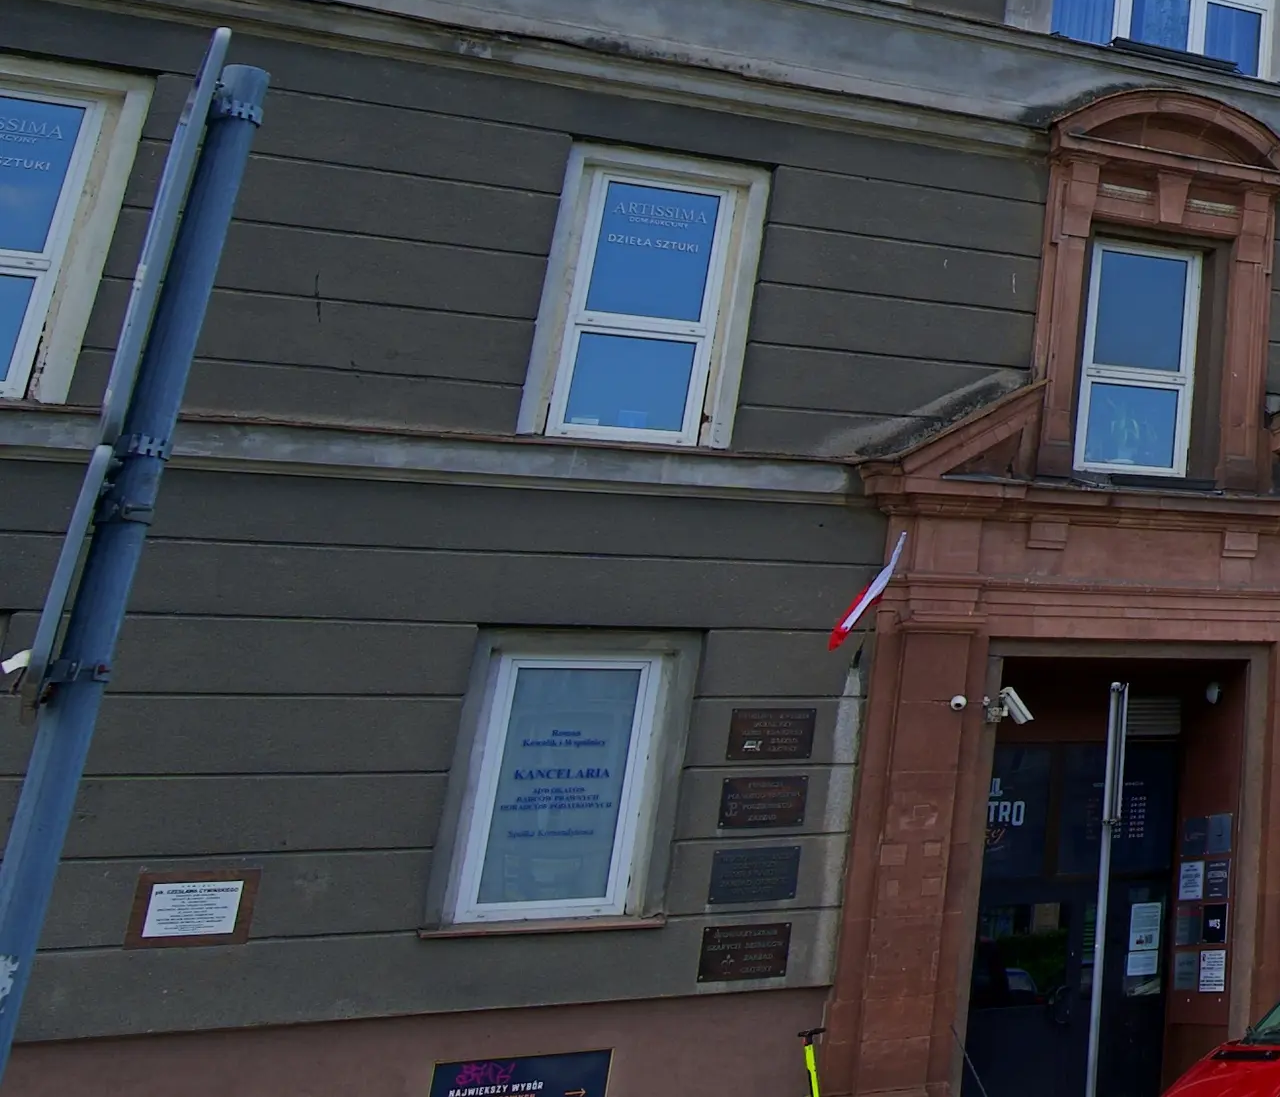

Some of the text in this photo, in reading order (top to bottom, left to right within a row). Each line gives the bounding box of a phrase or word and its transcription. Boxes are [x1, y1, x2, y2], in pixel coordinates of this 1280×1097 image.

[612, 202, 708, 225] ARTISSIMA
[607, 233, 699, 253] DZIEŁA SZTUKI
[514, 768, 610, 780] KANCELARIA
[988, 801, 1025, 827] TRO
[512, 1080, 544, 1091] WYBÓR
